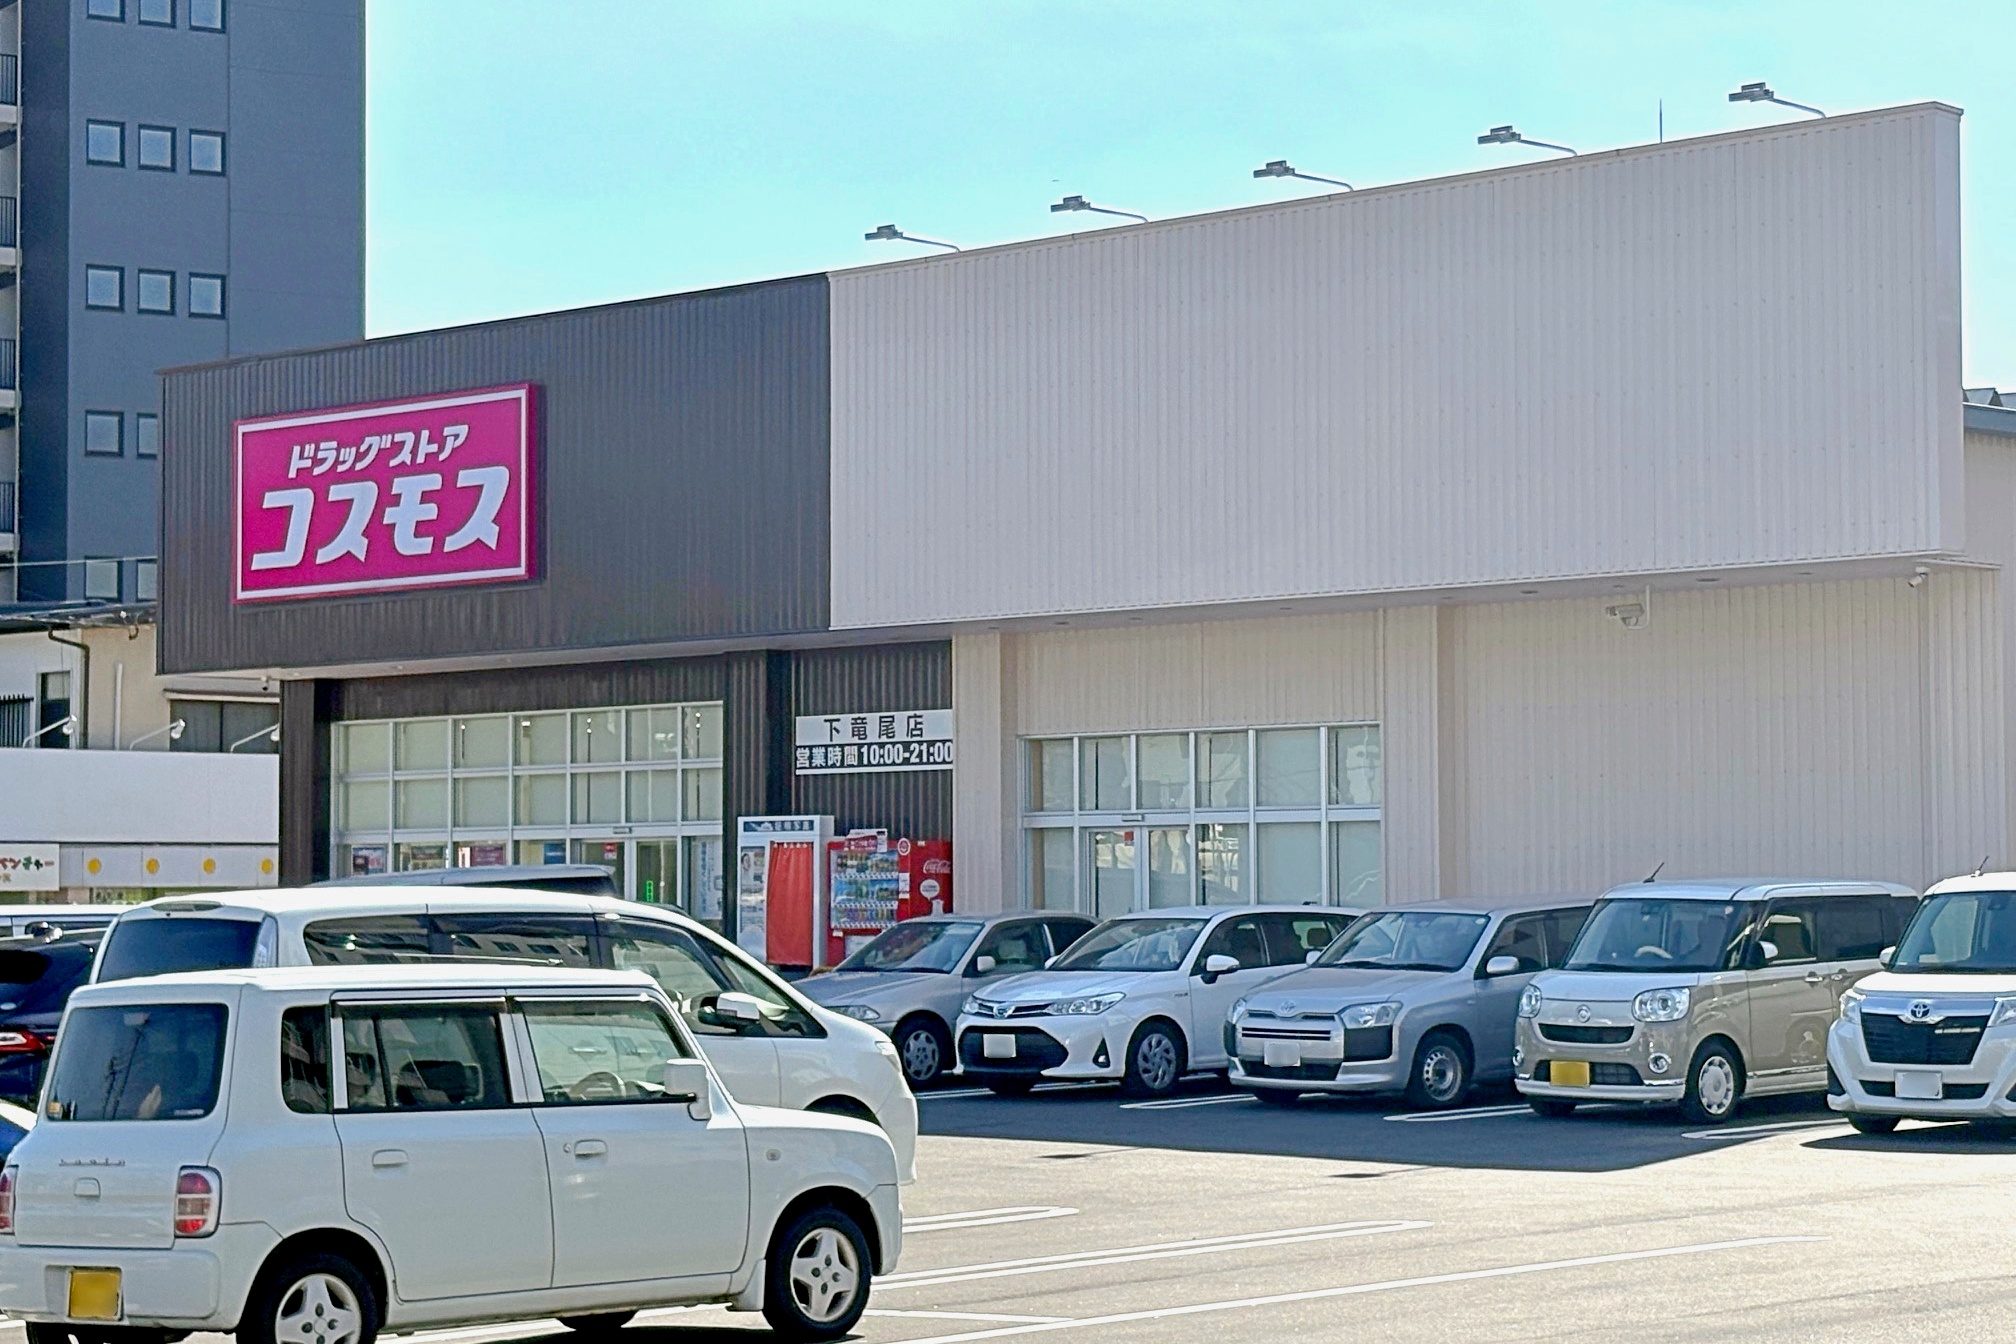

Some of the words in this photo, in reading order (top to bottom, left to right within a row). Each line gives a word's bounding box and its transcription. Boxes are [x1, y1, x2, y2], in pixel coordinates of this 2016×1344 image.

[288, 424, 470, 479] ドラッグストア
[250, 465, 510, 571] コスモス
[823, 713, 924, 743] 下竜尾店
